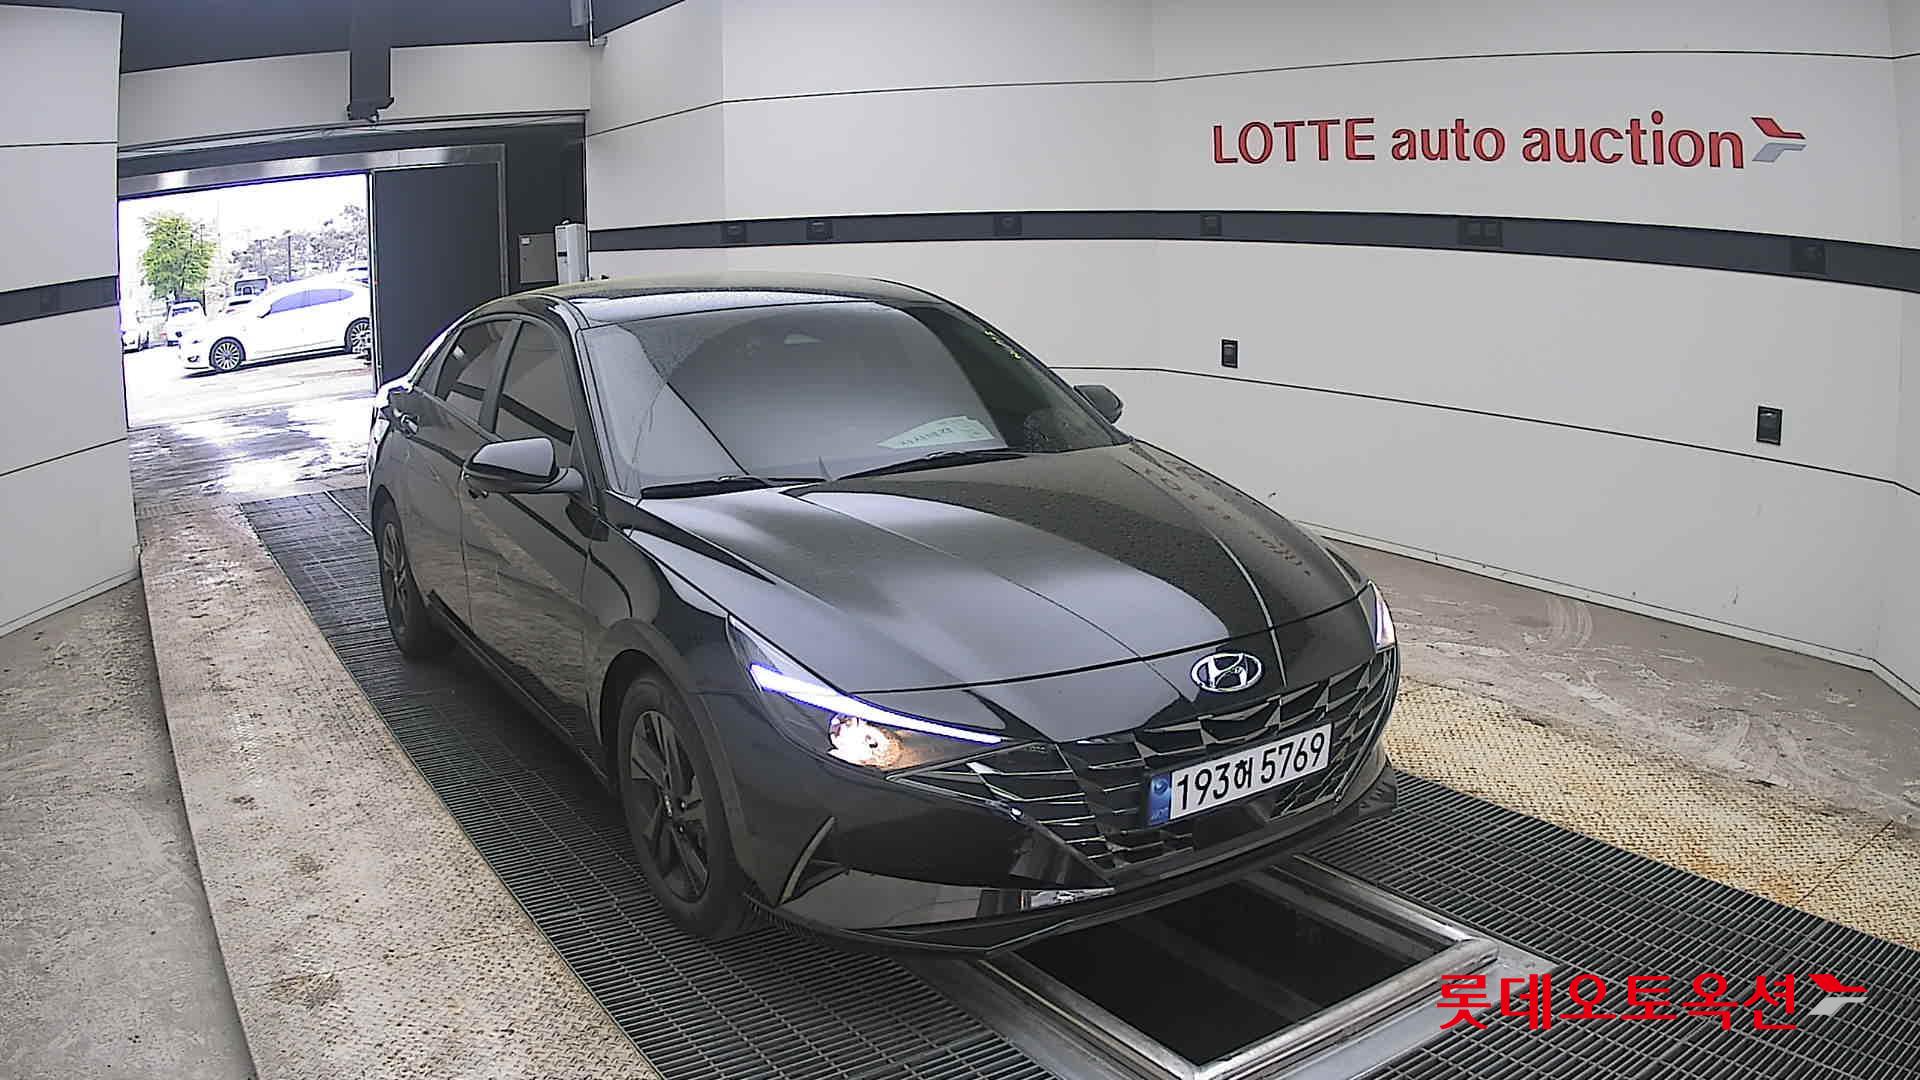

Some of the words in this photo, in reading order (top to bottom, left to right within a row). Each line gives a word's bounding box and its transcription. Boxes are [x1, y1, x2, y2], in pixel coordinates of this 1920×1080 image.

[1213, 117, 1376, 164] LOTTE
[1391, 118, 1506, 161] auto
[1522, 111, 1745, 169] auction
[1177, 757, 1253, 810] 193허
[1260, 732, 1325, 784] 5769
